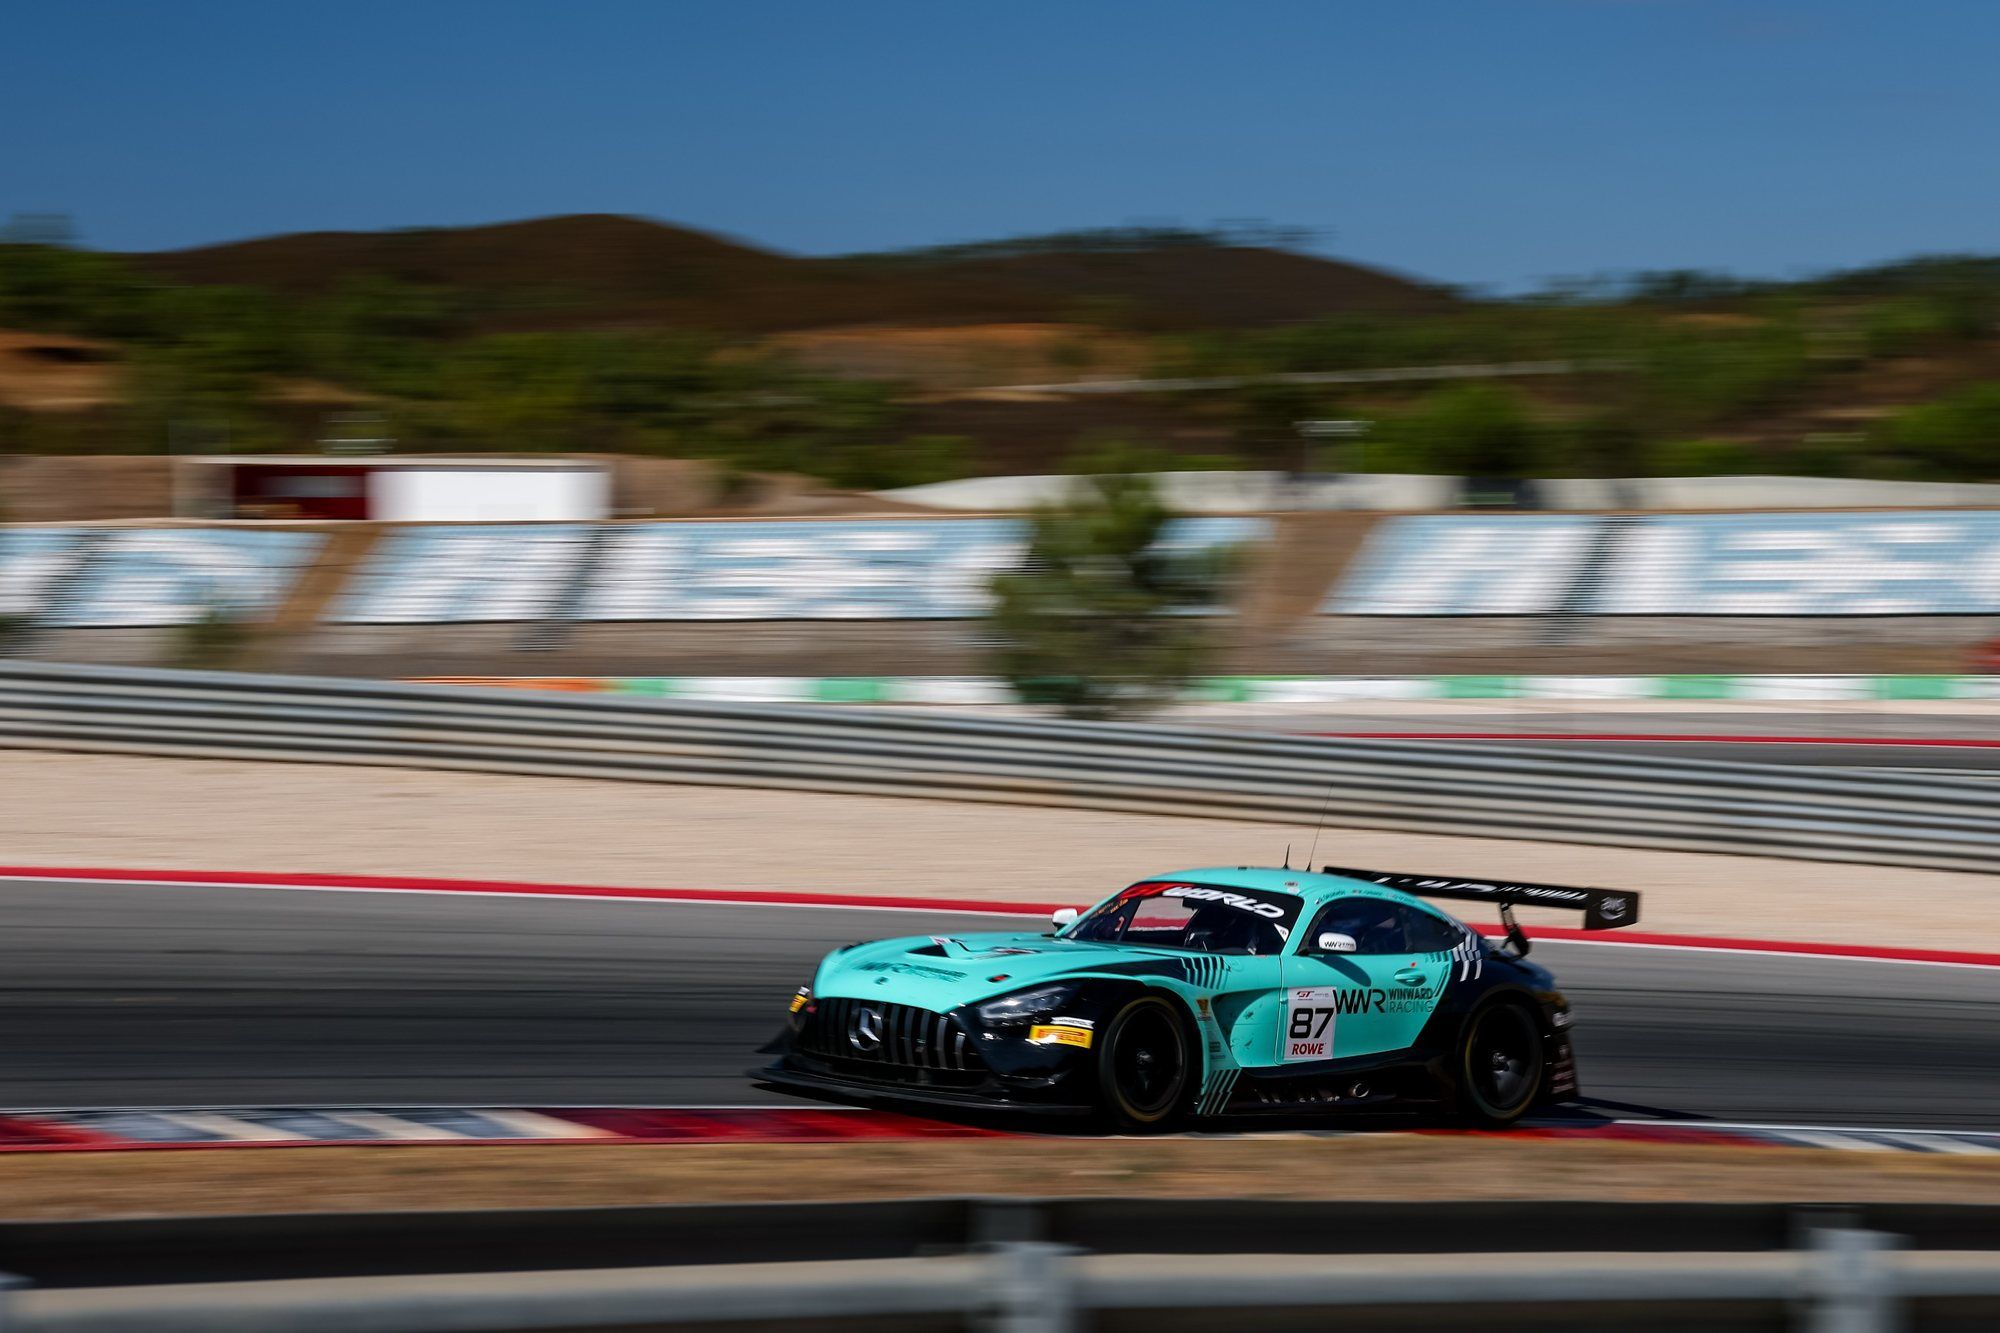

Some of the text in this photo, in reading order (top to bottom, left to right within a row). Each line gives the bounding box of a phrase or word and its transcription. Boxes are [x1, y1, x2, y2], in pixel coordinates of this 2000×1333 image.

[1162, 886, 1285, 919] WORLD
[1389, 988, 1434, 1000] WINWARD
[1389, 1001, 1435, 1013] RACING
[1289, 1007, 1335, 1040] 87
[1291, 1043, 1325, 1056] ROWE
